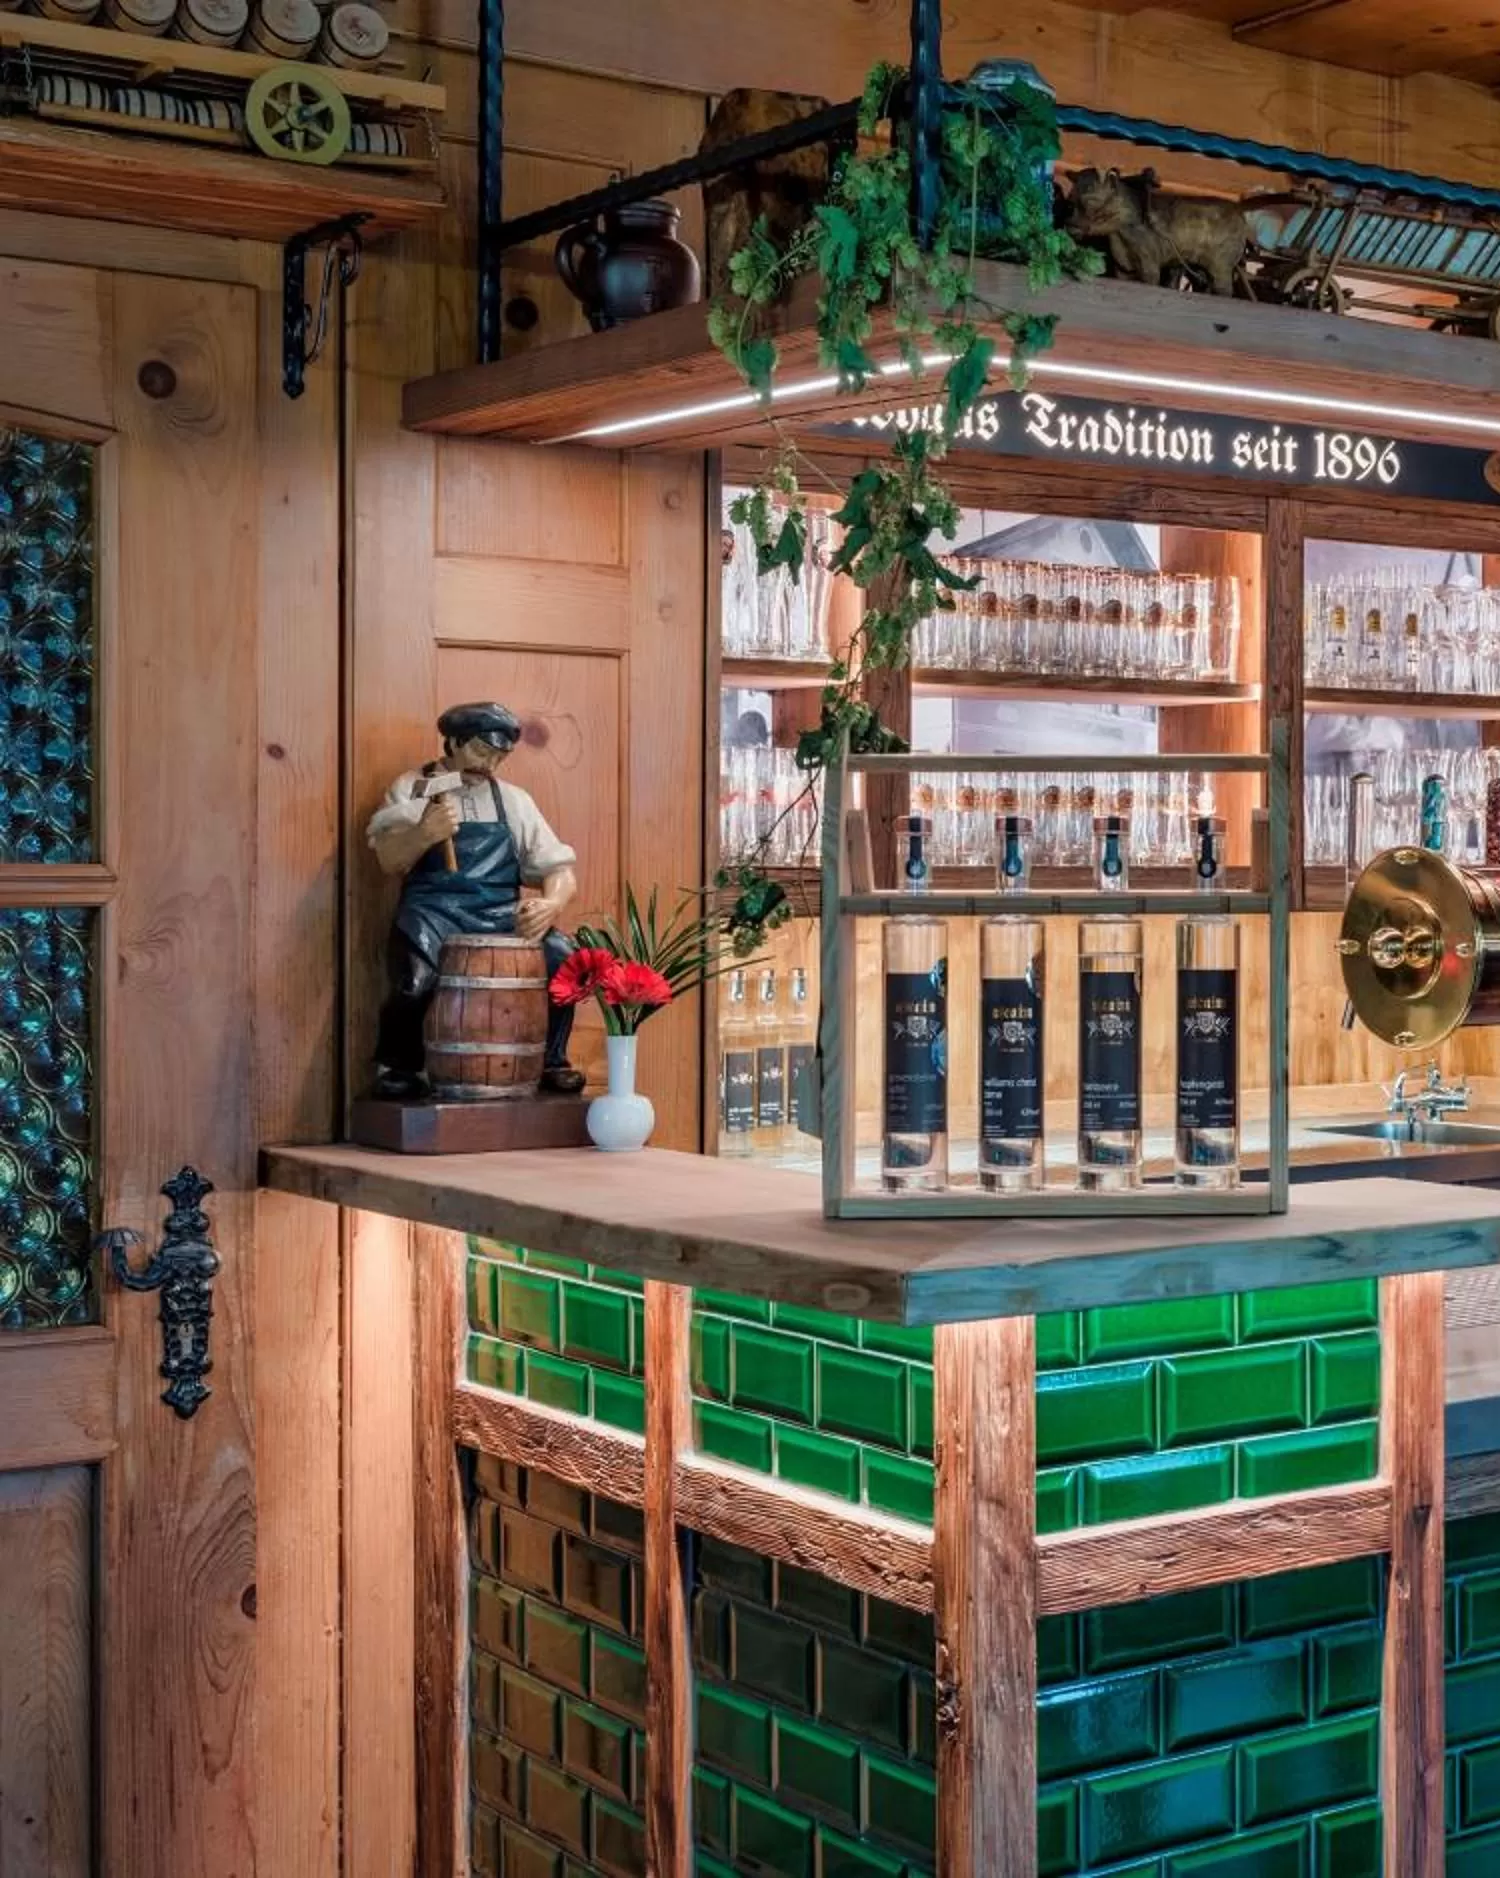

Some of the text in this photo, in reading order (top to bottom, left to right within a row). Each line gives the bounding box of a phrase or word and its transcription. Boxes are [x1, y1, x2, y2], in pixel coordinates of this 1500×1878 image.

[1021, 393, 1215, 464] Tradition
[1231, 425, 1298, 474] seit
[1313, 432, 1400, 484] 1896
